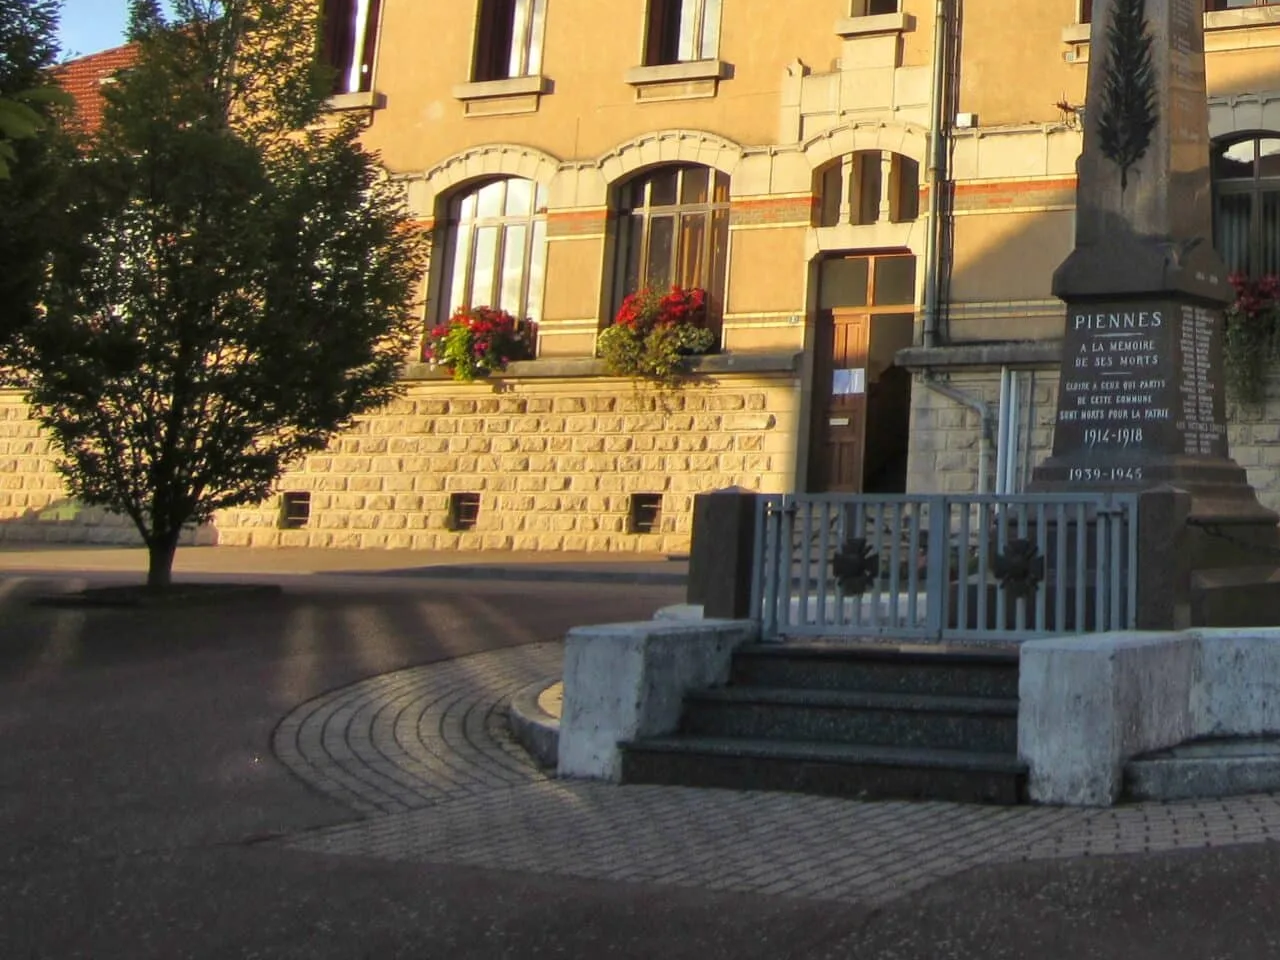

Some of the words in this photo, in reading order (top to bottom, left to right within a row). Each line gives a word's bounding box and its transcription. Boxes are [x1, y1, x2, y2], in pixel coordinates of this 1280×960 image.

[1075, 311, 1162, 329] PIENNES
[1092, 341, 1104, 352] LA
[1075, 357, 1088, 367] DE
[1094, 356, 1113, 367] SES
[1120, 354, 1159, 366] MORTS
[1101, 381, 1119, 390] CEUX
[1077, 396, 1086, 405] DE
[1090, 395, 1112, 405] CETTE
[1081, 410, 1104, 420] MORTS
[1108, 409, 1128, 419] POUR
[1131, 409, 1141, 419] LA
[1084, 428, 1143, 448] 1914-1918
[1069, 467, 1143, 481] 1939-1945
